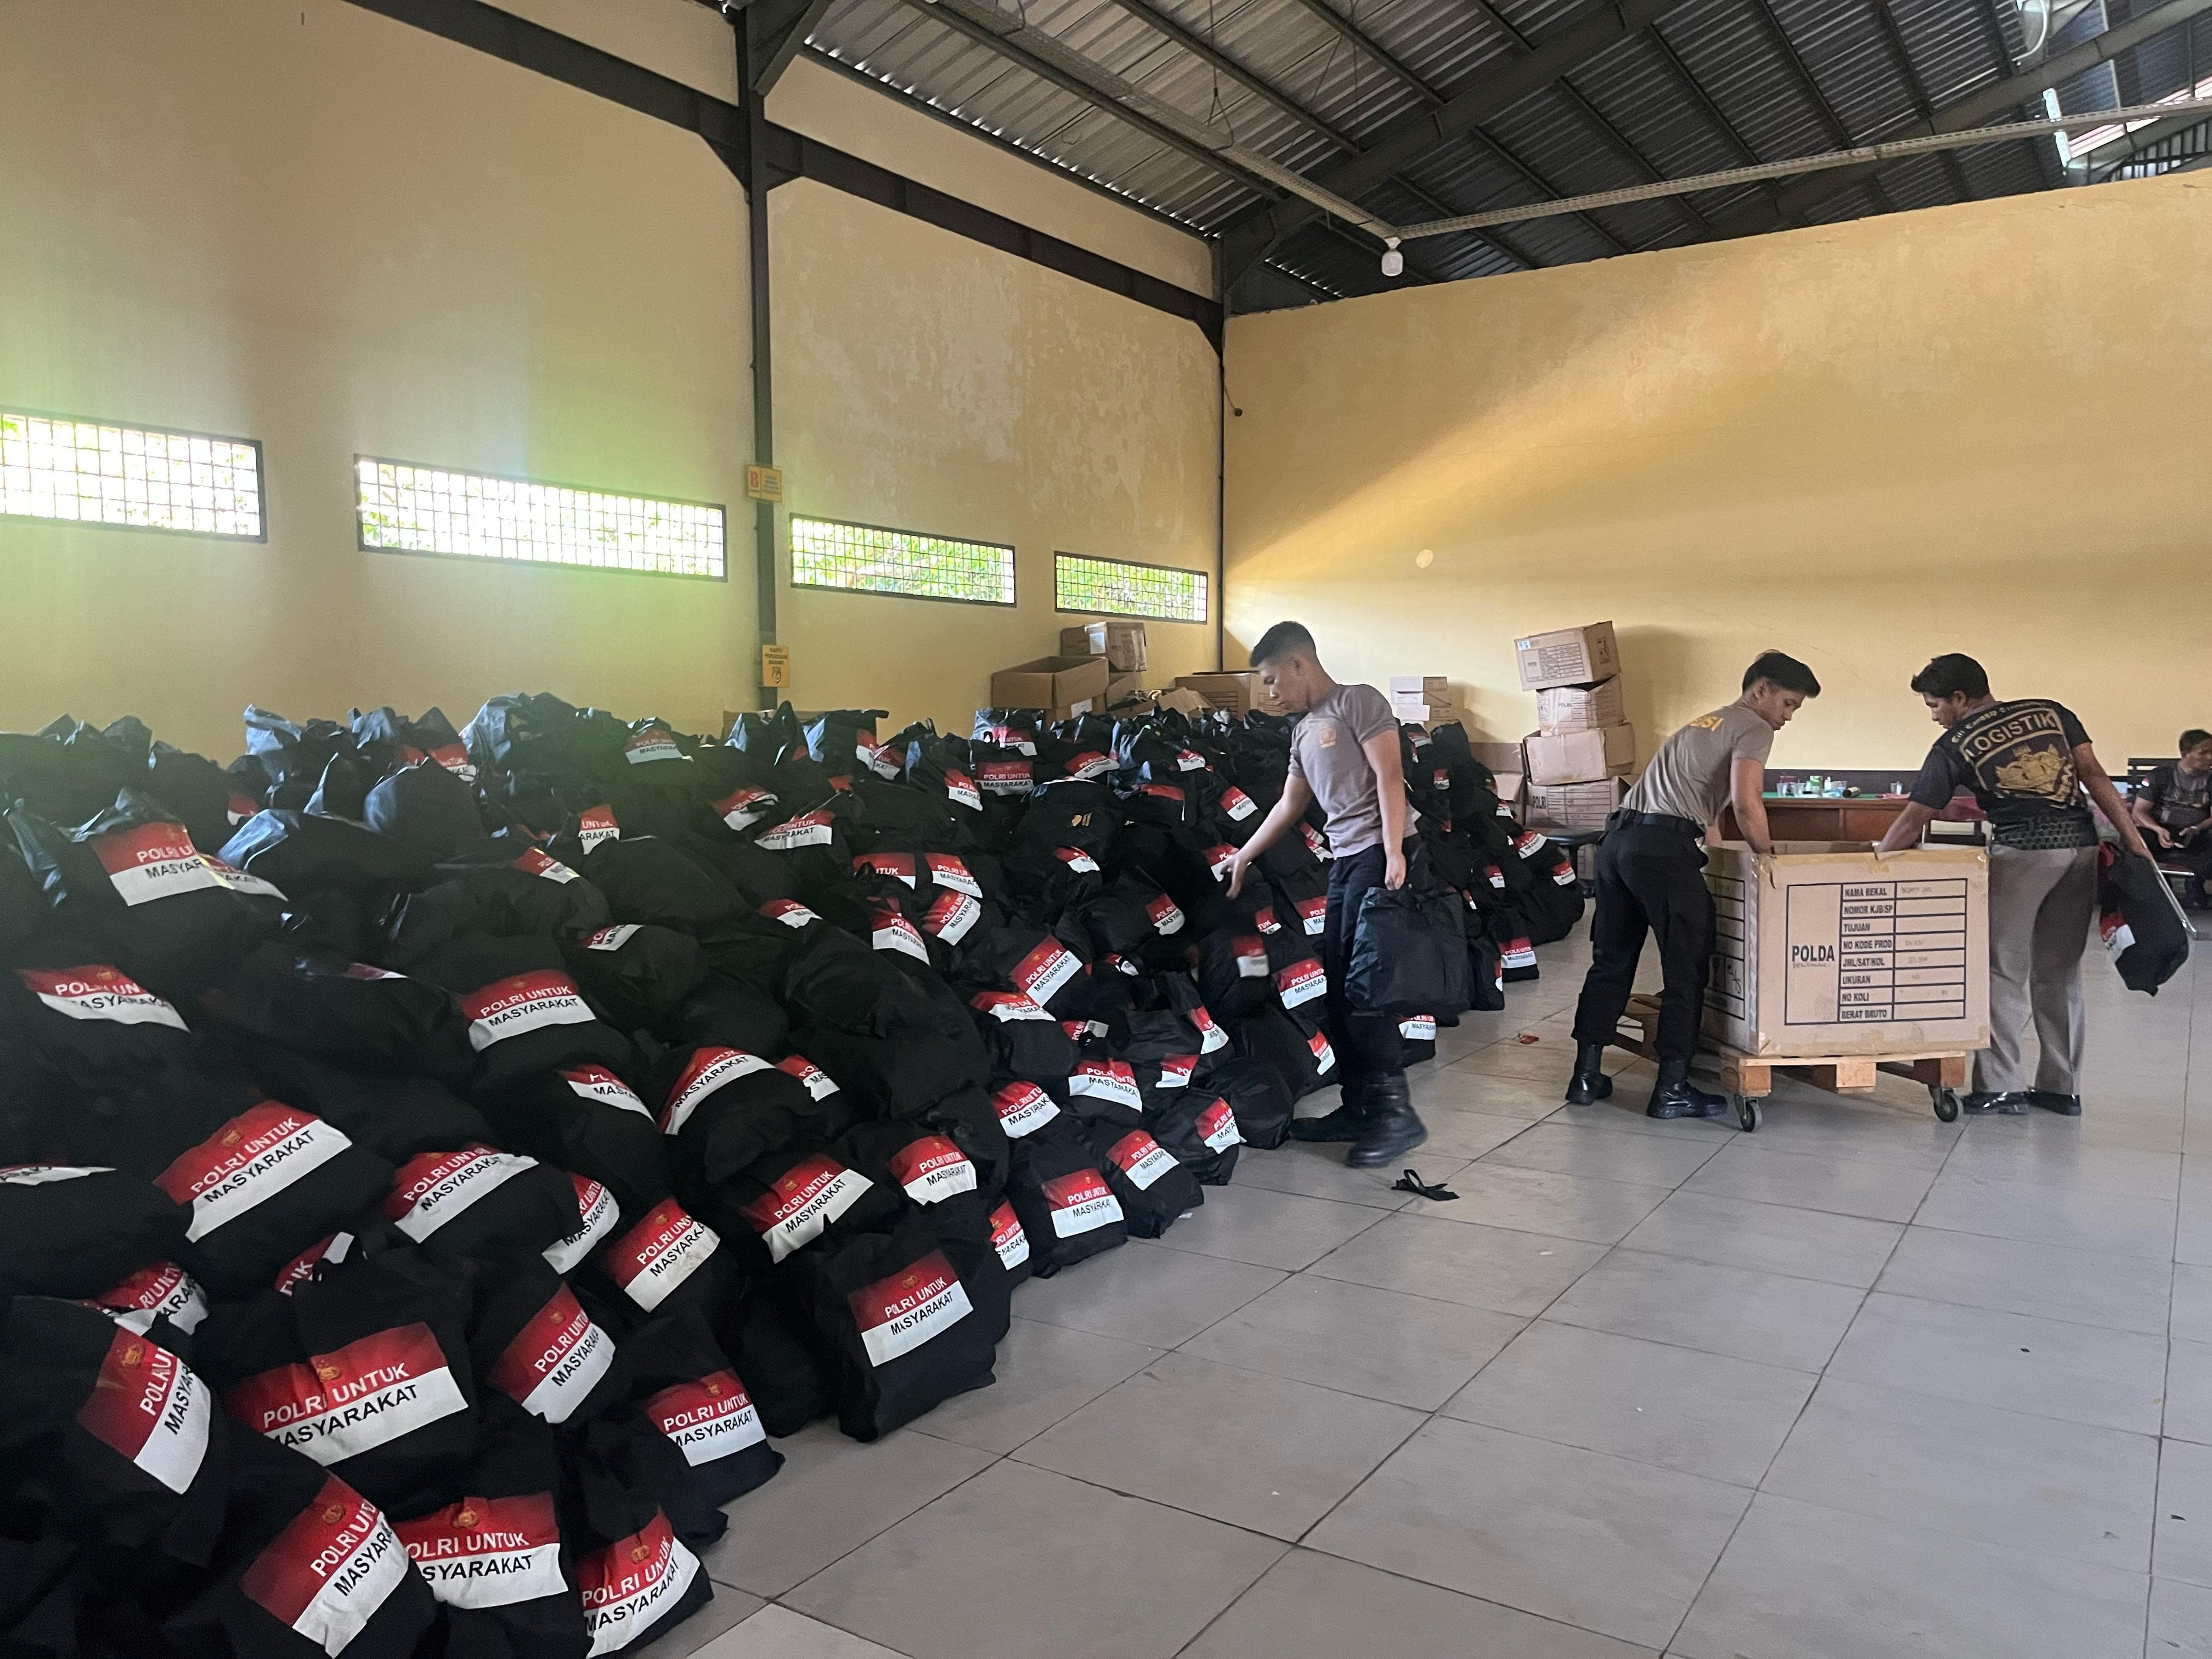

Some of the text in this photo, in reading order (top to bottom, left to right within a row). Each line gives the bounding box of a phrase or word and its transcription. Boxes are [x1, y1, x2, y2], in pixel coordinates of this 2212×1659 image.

[1966, 713, 2056, 758] LOGISTIK
[579, 830, 614, 840] ARAKAT
[1844, 887, 1887, 897] NAMA BEKAL
[949, 900, 973, 928] MASYARA
[1257, 919, 1272, 930] TUK
[1844, 905, 1868, 915] NOMOR
[1843, 923, 1870, 932] TUJUAN
[1843, 939, 1892, 950] NO KODE PROD
[1025, 949, 1063, 985] POLRI UNTUK
[1791, 945, 1835, 962] POLDA
[1034, 955, 1070, 991] MASYARAKAT
[1842, 975, 1871, 985] UKURAN
[481, 985, 572, 1017] POLRI UNTUK
[488, 998, 579, 1027] MASYARAKAT
[1842, 992, 1869, 1002] NO KOLI
[1842, 1009, 1887, 1019] BERAT BRUTO
[674, 1056, 748, 1108] MASYARAKAT
[191, 1117, 300, 1193] POLRI UNTUK
[204, 1130, 315, 1203] MASYARAKAT
[403, 1165, 450, 1201] POLRI
[774, 1171, 834, 1220] POLRI UNTUK
[1067, 1190, 1092, 1205] POLRI
[785, 1178, 847, 1233] MASYARAKAT
[636, 1229, 674, 1265] POLRI
[884, 1277, 947, 1318] POLRI UNTUK
[890, 1291, 953, 1335] MASYARAKAT
[534, 1331, 573, 1373] POLRI
[263, 1363, 409, 1429] POLRI UNTUK
[663, 1392, 749, 1432] POLRI UNTUK
[310, 1528, 359, 1578] POLRI
[405, 1532, 529, 1560] OLRI UNTUK
[422, 1554, 532, 1581] SYARAKAT
[582, 1574, 640, 1606] POLRI
[584, 1558, 678, 1632] MASYARAKAT
